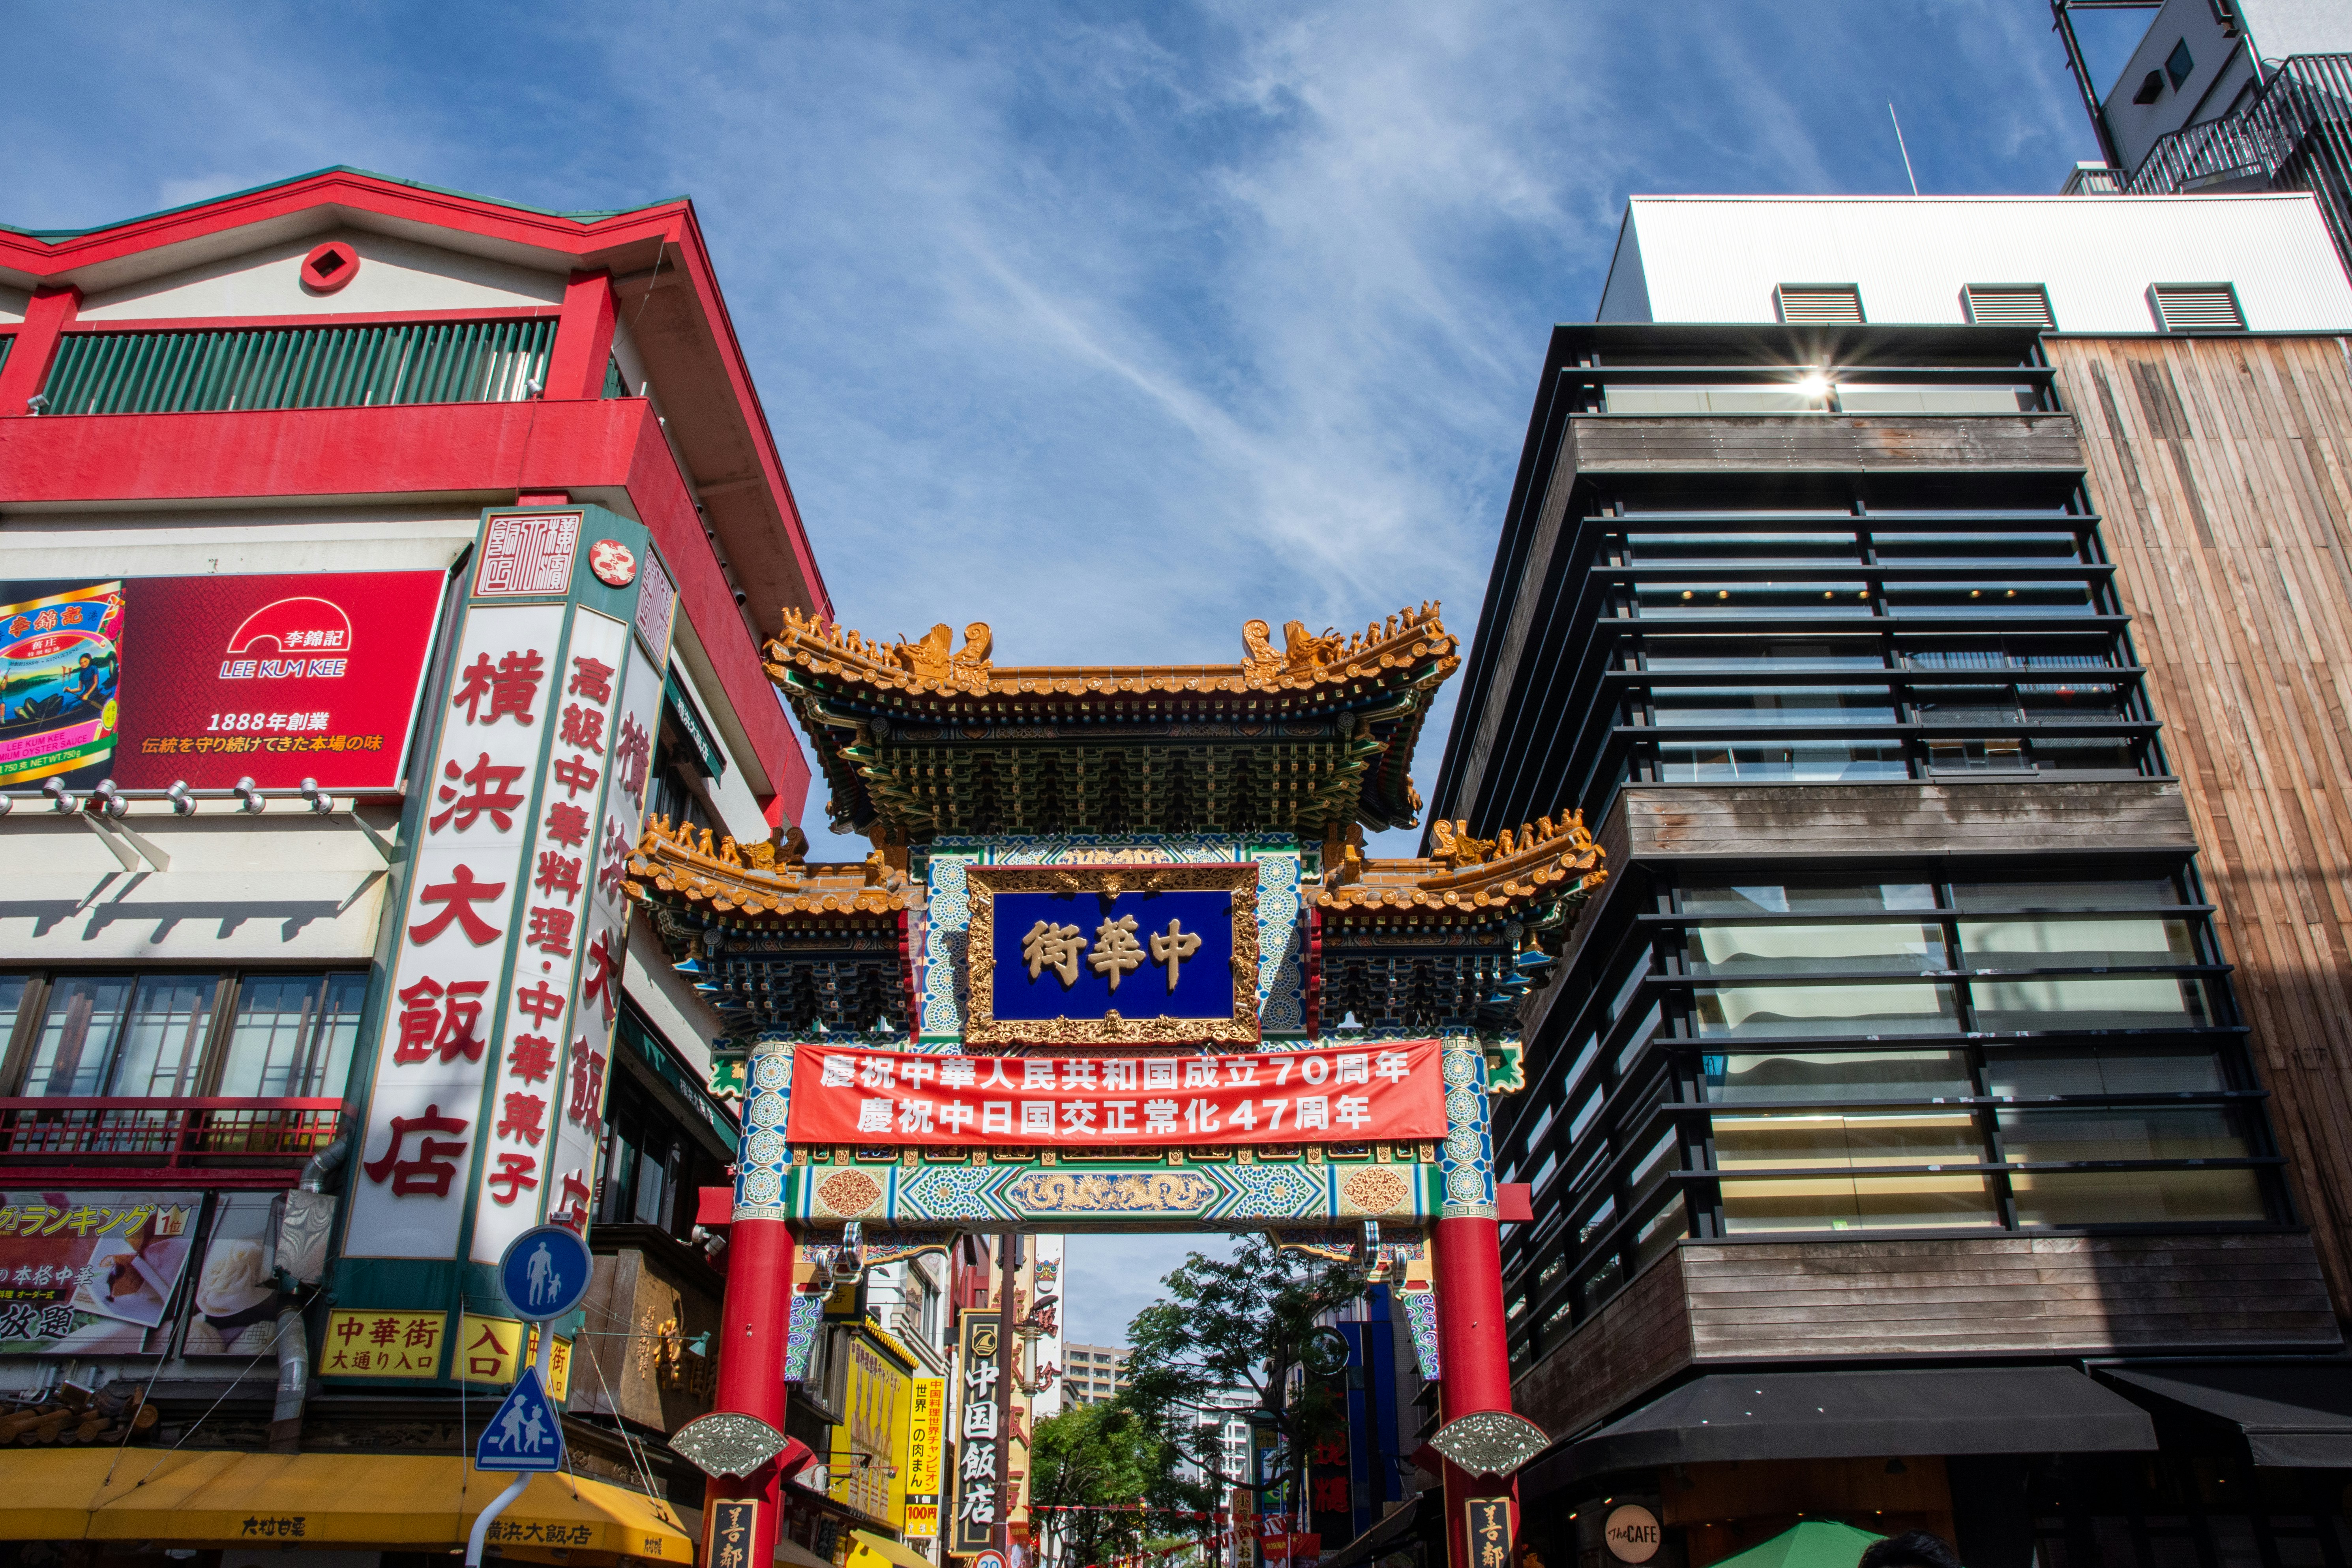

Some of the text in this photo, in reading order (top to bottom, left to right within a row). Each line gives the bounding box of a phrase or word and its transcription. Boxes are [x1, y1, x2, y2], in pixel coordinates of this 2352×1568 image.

[9, 606, 83, 638] 李錦記
[284, 629, 345, 648] 李錦記
[220, 658, 347, 678] LEE KUM KEE
[206, 712, 329, 732] 1888年創業
[7, 732, 65, 751] LEE KUM KEE
[22, 743, 58, 757] OYSTER
[60, 734, 87, 748] SAUCE
[141, 734, 383, 754] 伝統を守り続けてきた本場の味
[363, 649, 544, 1198] 横浜大飯店
[1023, 914, 1201, 992] 中華街
[820, 1051, 1411, 1091] 慶祝中華人民共和国成立70周年
[857, 1094, 1372, 1135] 慶祝中日国交正常化47周年
[161, 1215, 181, 1234] 1位
[337, 1316, 439, 1350] 中華街
[329, 1351, 433, 1370] 大通り入口
[467, 1324, 509, 1377] 入口
[529, 1333, 566, 1375] 中街
[851, 1341, 902, 1394] 中国料理世界チャンピオン
[910, 1383, 927, 1487] 世界一の肉まん
[925, 1380, 942, 1492] 中国料理世界チャンピオン
[959, 1360, 999, 1525] 中国飯店
[915, 1495, 931, 1504] 1個
[907, 1506, 937, 1519] 100円
[242, 1516, 306, 1537] 大粒甘栗
[487, 1521, 592, 1546] 横浜大飯店
[1608, 1525, 1657, 1543] The CAFE
